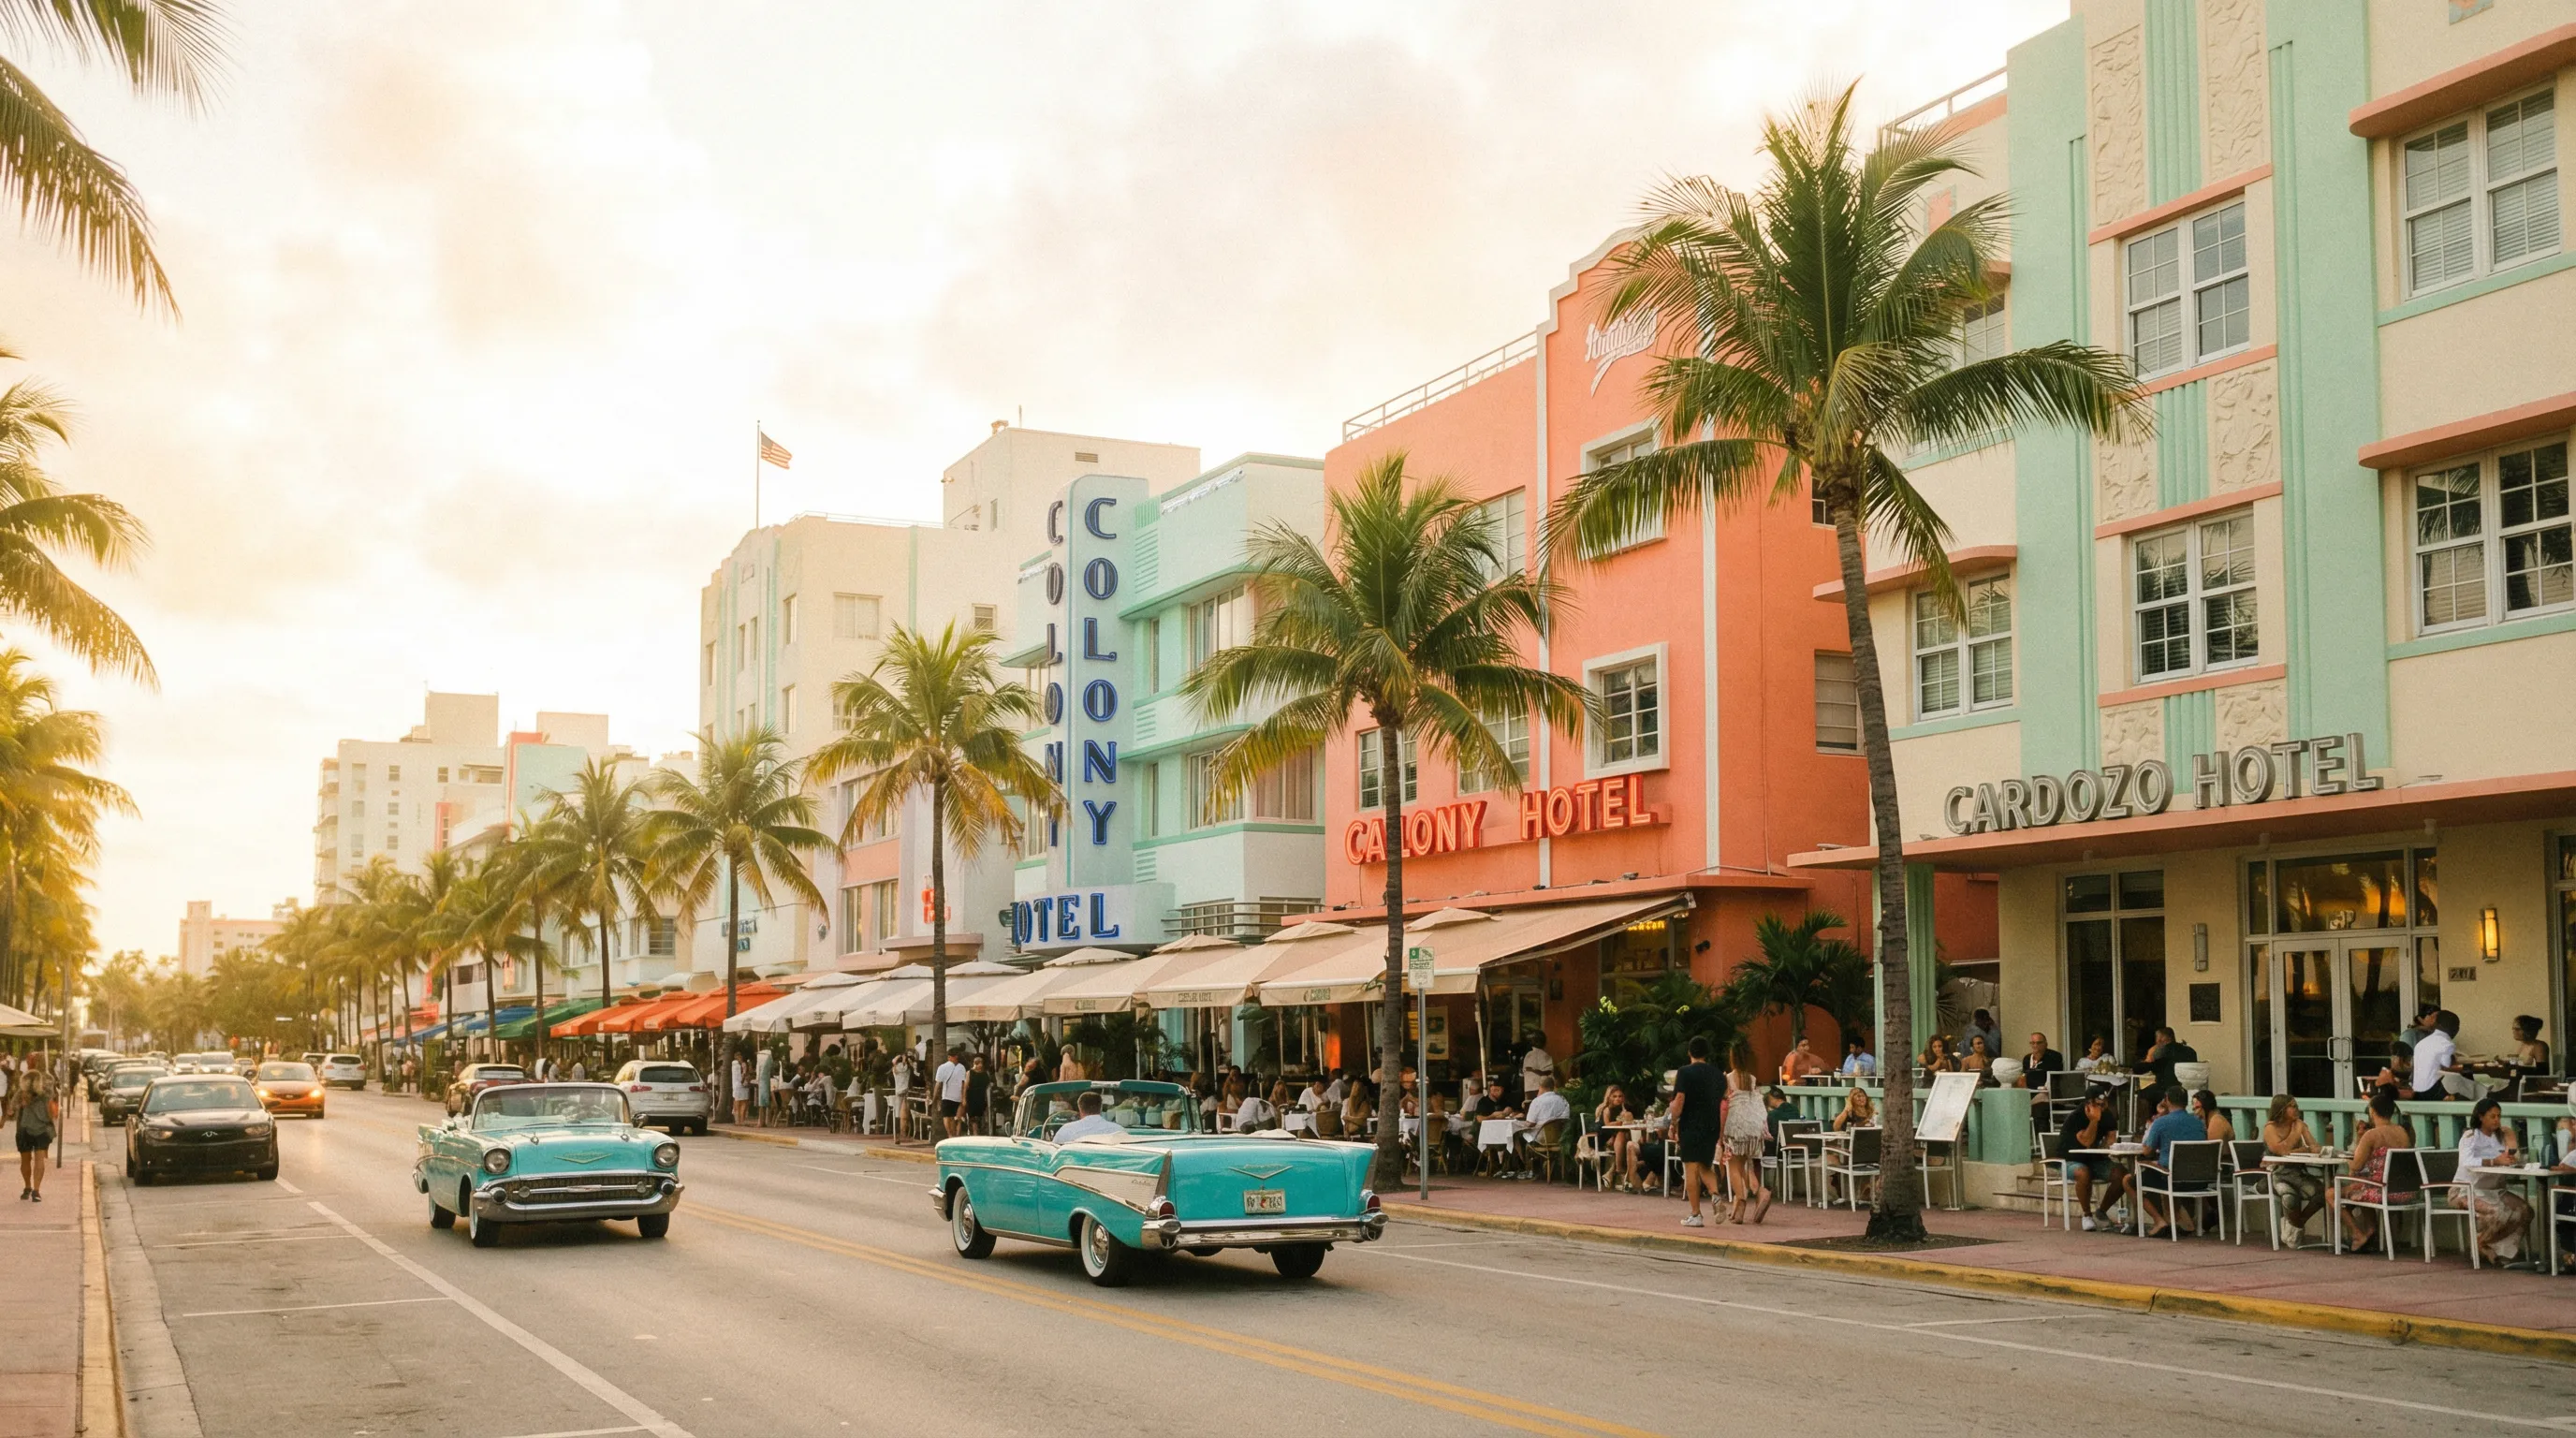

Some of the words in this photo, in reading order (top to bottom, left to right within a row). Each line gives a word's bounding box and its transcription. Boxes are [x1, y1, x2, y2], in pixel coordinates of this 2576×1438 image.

[1083, 497, 1118, 845] COLONY
[1520, 774, 1659, 841] HOTEL
[1944, 759, 2174, 835] CARDOZO
[2192, 732, 2383, 809] HOTEL
